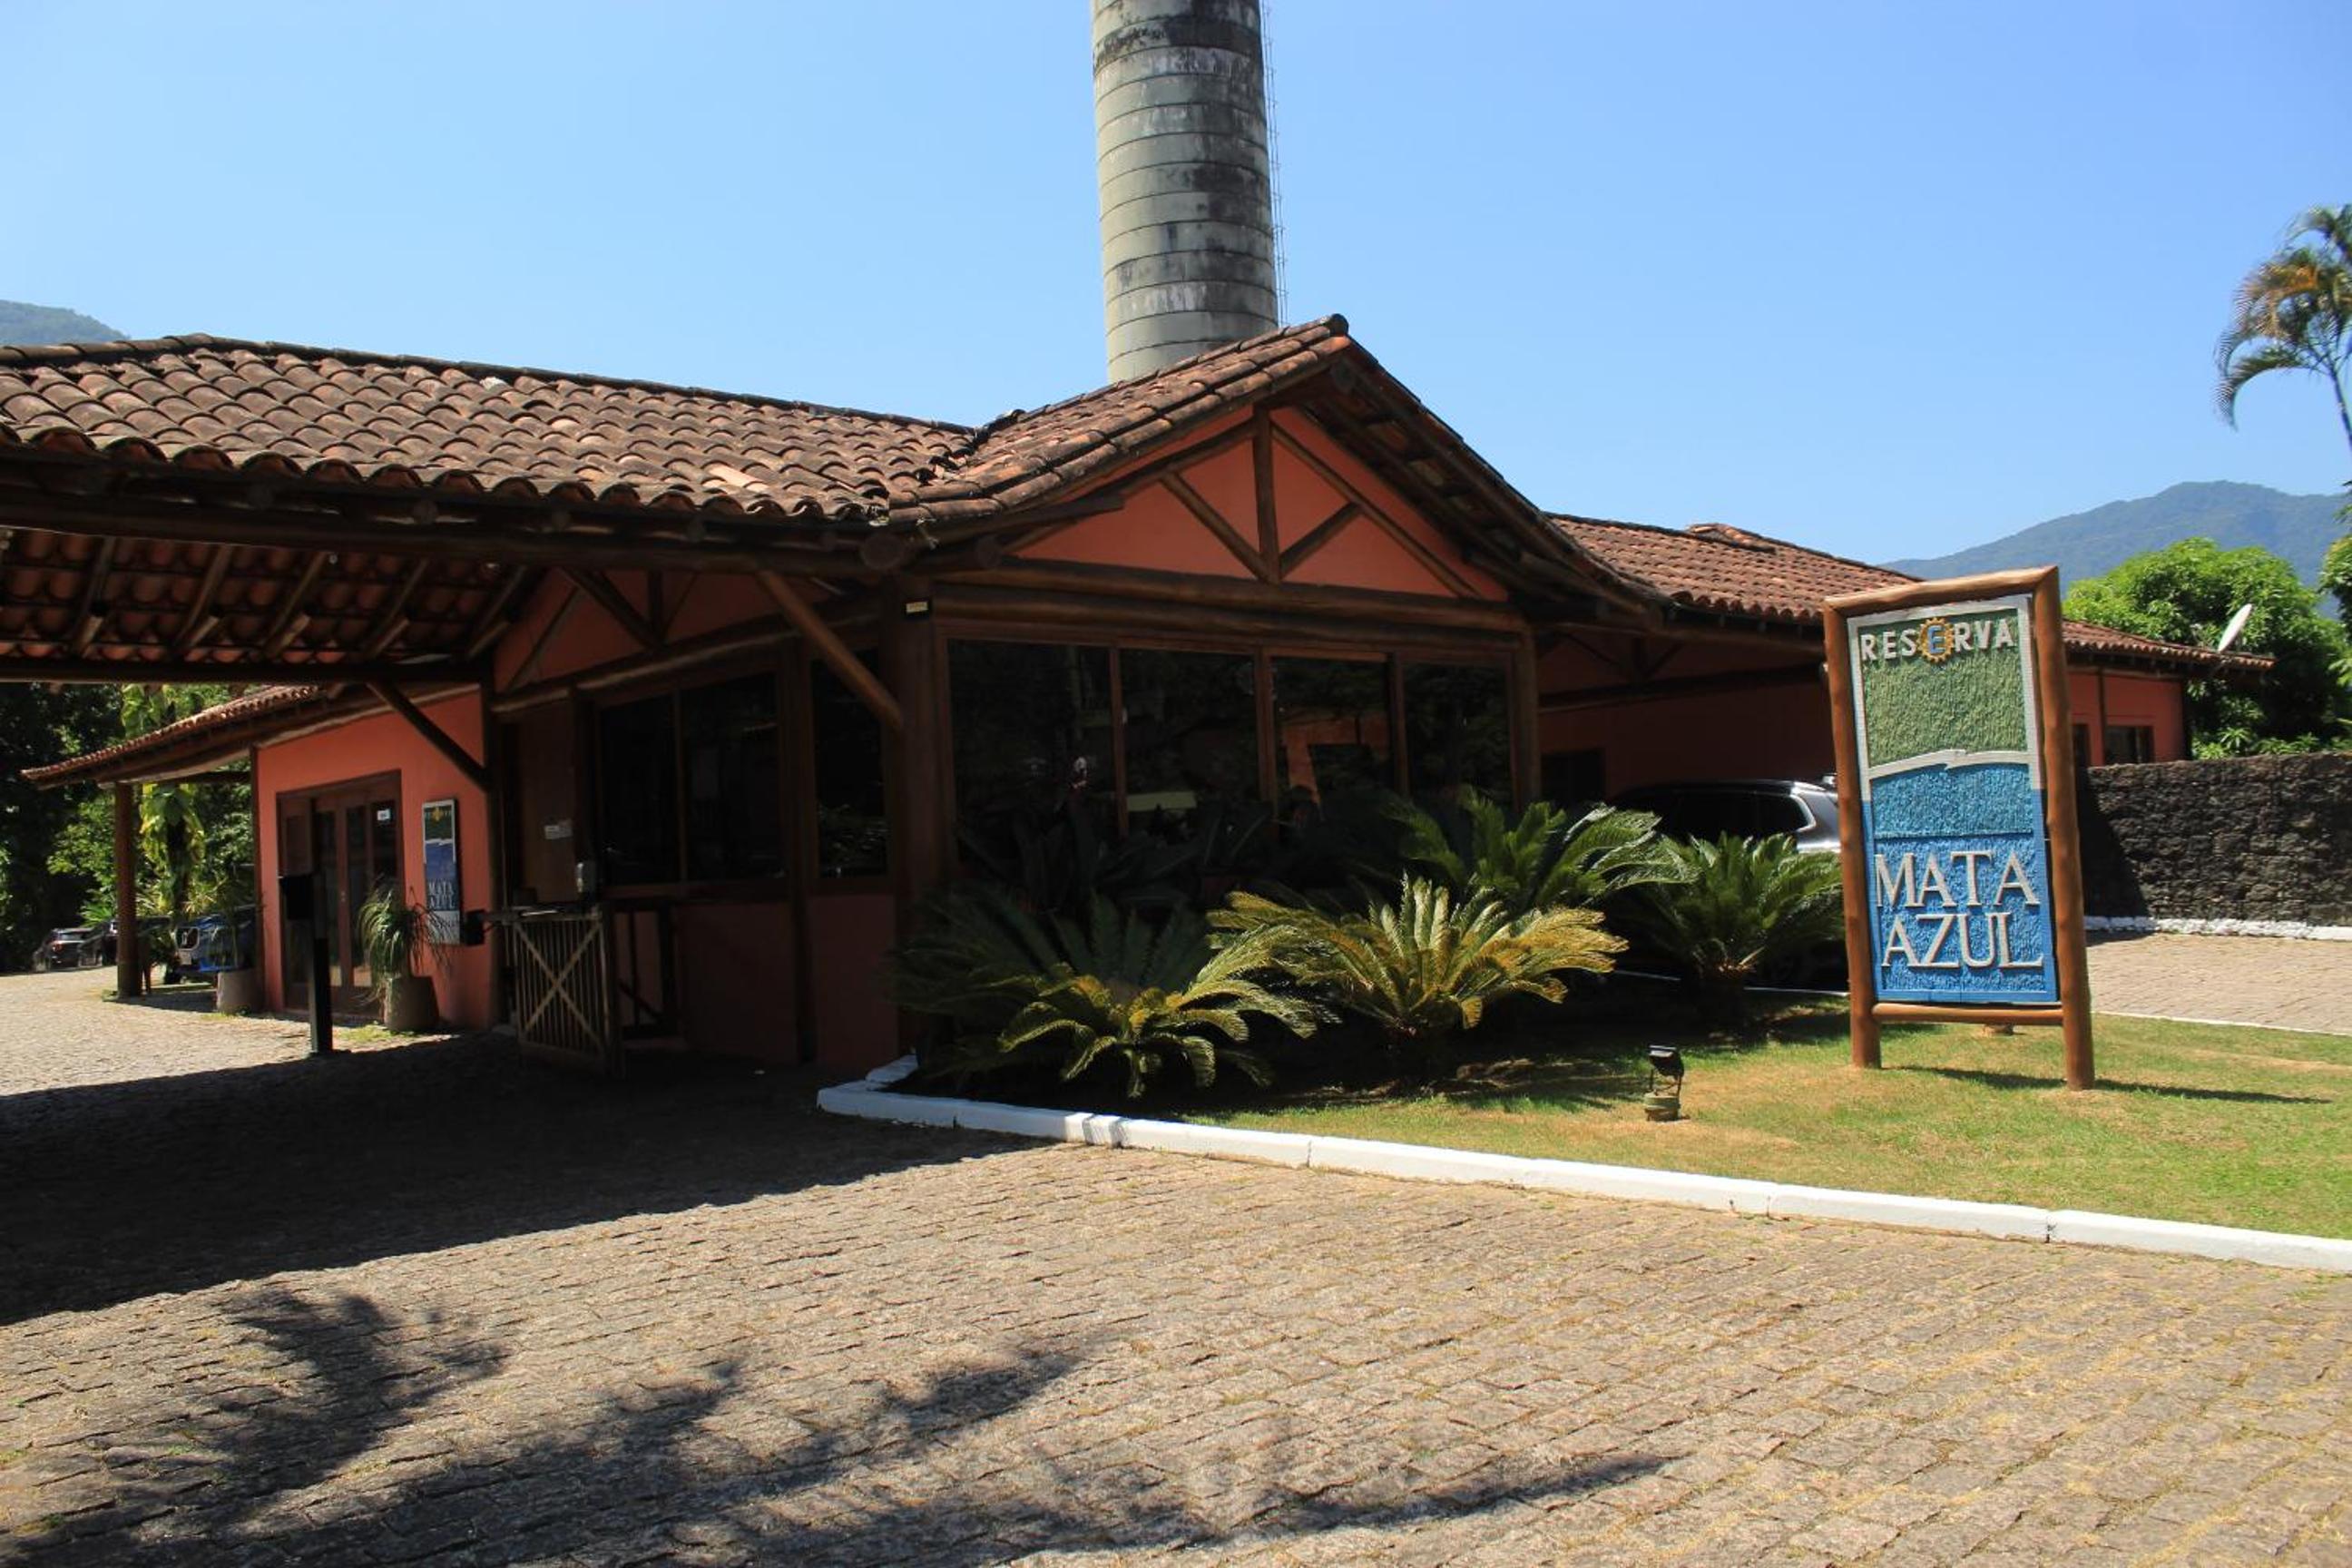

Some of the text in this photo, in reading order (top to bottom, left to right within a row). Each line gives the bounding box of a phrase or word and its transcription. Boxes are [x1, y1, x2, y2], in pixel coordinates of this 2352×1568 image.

[1860, 619, 2014, 662] RESERVA
[1874, 850, 2041, 907] MATA
[1881, 911, 2043, 968] AZUL
